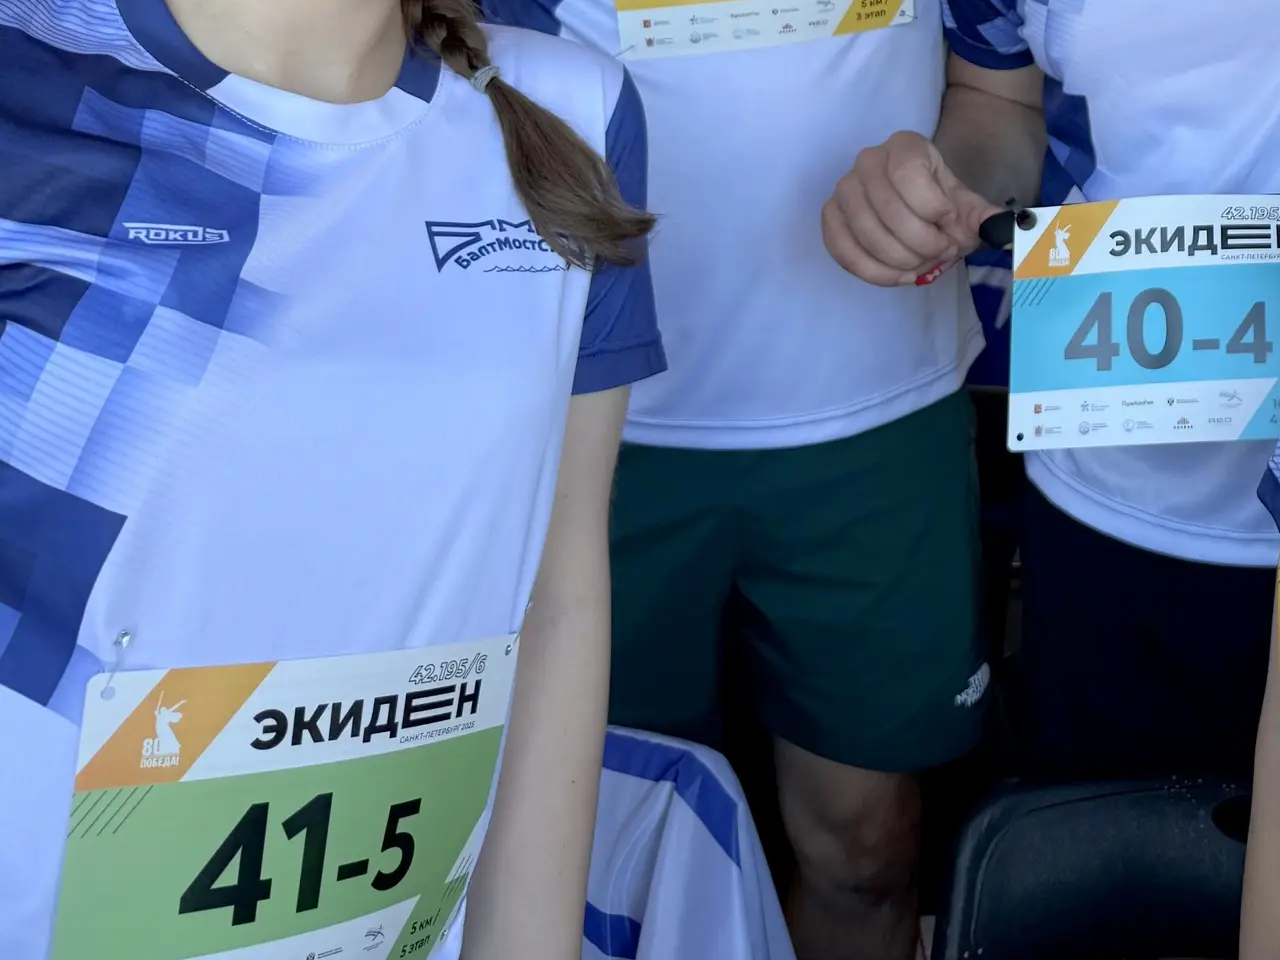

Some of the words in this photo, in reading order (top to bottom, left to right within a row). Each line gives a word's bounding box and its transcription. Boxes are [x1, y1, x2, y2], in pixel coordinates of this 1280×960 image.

[856, 12, 863, 21] 3
[864, 9, 887, 20] этап
[122, 222, 231, 244] ROKUS
[1064, 286, 1275, 372] 40-4
[408, 652, 488, 685] 42.195/6
[250, 679, 482, 751] ЭКИДЕН
[399, 723, 461, 743] САНКТ-ПЕТЕРБУРГ
[461, 720, 475, 731] 2025
[178, 791, 422, 927] 41-5
[410, 921, 418, 935] 5
[419, 915, 433, 931] км
[400, 944, 408, 958] 5
[408, 934, 431, 954] этап
